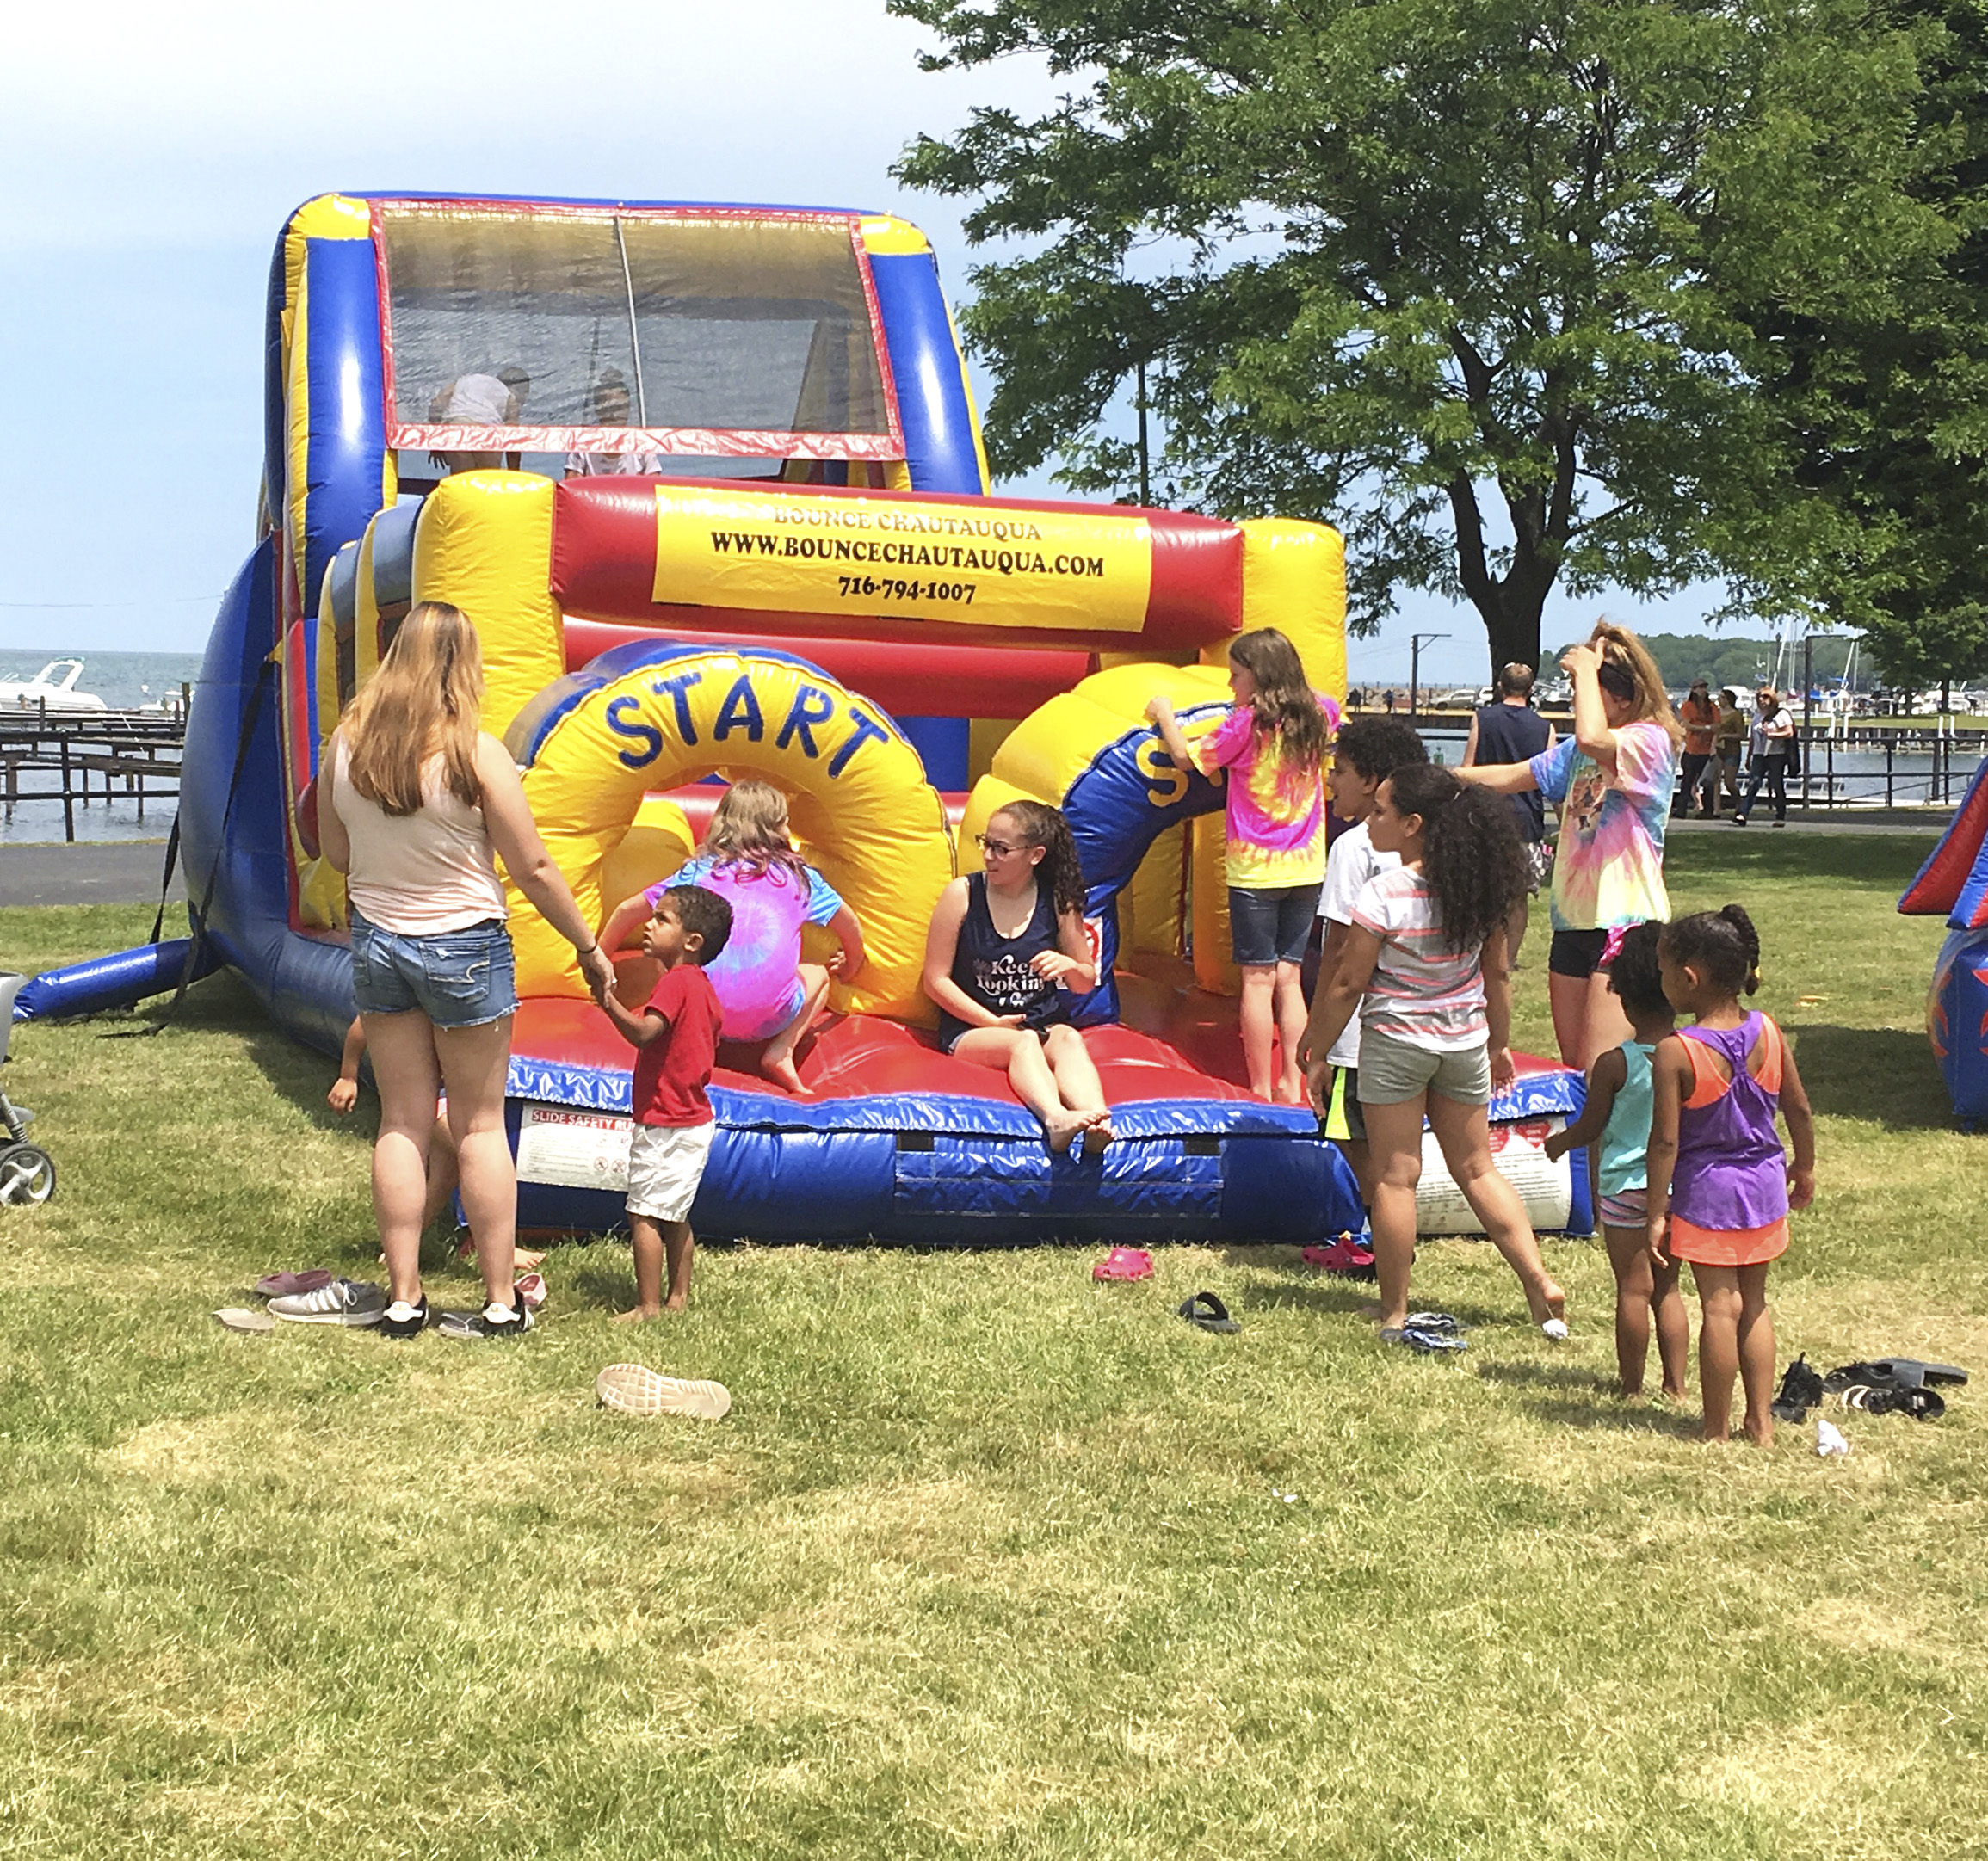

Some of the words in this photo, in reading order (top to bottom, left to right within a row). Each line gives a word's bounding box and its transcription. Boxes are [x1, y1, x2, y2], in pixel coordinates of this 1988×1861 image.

[774, 506, 872, 530] BOUNCE
[878, 512, 1042, 542] CHAUTAUQUA
[711, 531, 1105, 577] WWW.BOUNCECHAUTAUQUA.COM
[837, 576, 976, 605] 716-794-1007
[605, 672, 890, 779] START
[533, 1110, 565, 1124] SLIDE
[568, 1113, 613, 1129] SAFETY
